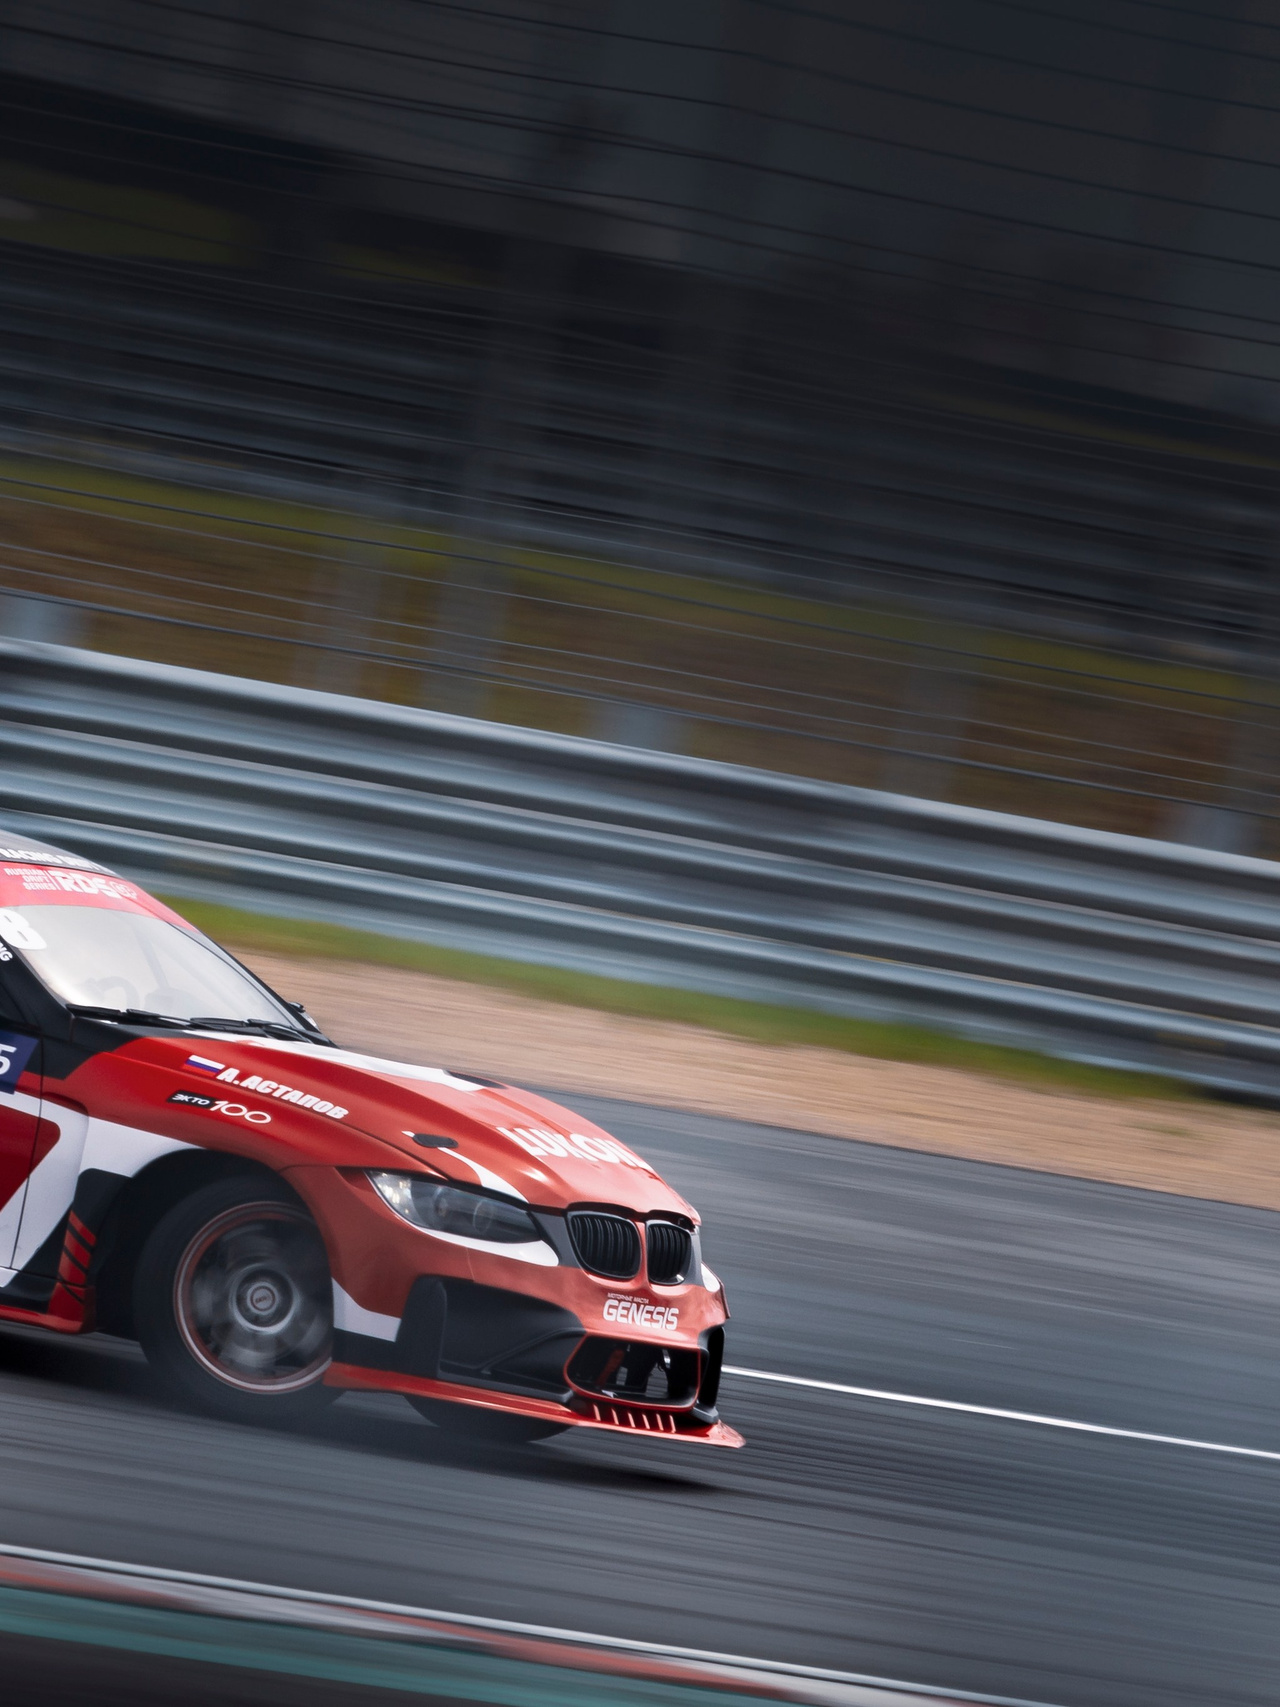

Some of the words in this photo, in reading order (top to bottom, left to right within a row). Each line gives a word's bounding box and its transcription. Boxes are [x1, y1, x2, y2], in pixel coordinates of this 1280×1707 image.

[47, 870, 123, 899] RDS
[172, 1093, 210, 1106] ЭКТО
[210, 1099, 272, 1125] 100
[216, 1067, 349, 1120] А.АСТАПОВ
[496, 1126, 655, 1172] LUKOIL
[603, 1299, 679, 1330] GENESIS
